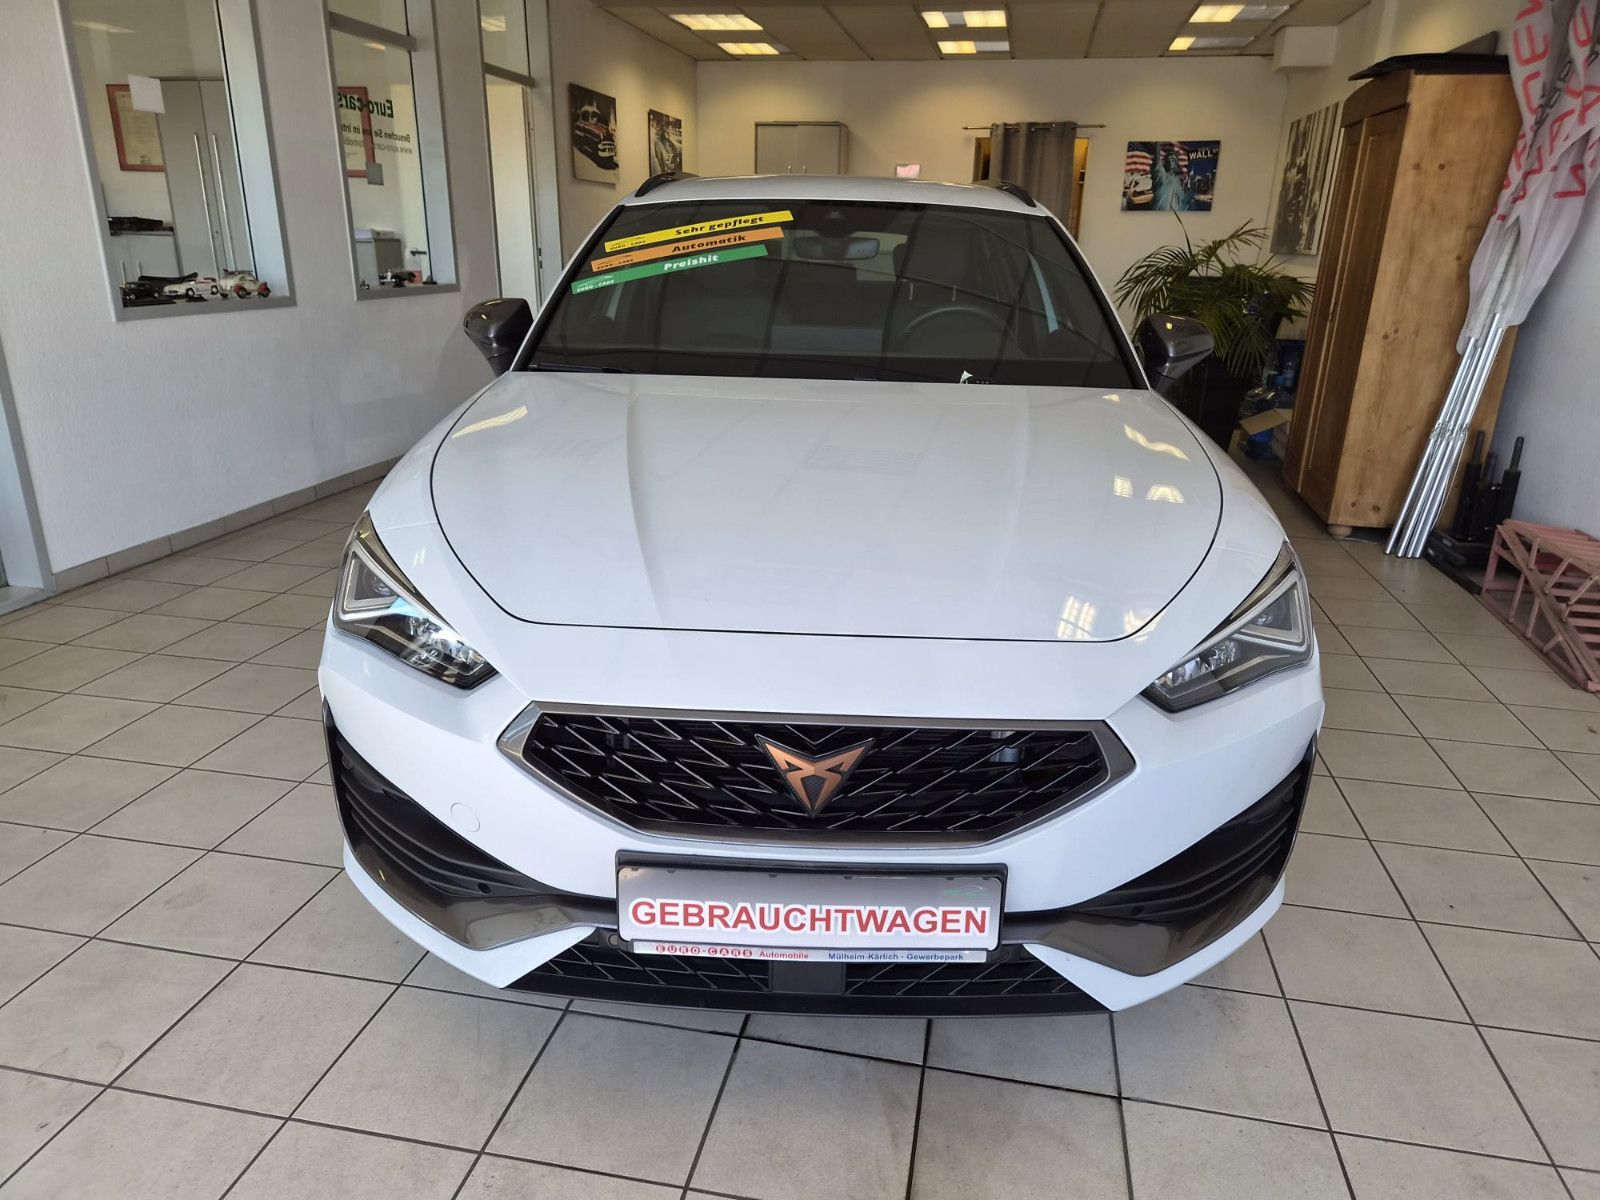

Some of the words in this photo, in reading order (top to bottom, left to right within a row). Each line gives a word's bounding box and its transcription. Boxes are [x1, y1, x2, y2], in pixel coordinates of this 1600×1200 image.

[1189, 150, 1213, 160] WALL
[674, 224, 706, 236] Sehr
[708, 216, 764, 231] gepflegt
[671, 234, 747, 253] Automatik
[663, 254, 719, 271] Preishit
[630, 900, 988, 935] GEBRAUCHTWAGEN
[759, 950, 809, 960] Automobile
[828, 952, 899, 961] Mülheim-Kärlich
[906, 953, 964, 962] Gewerbepark
